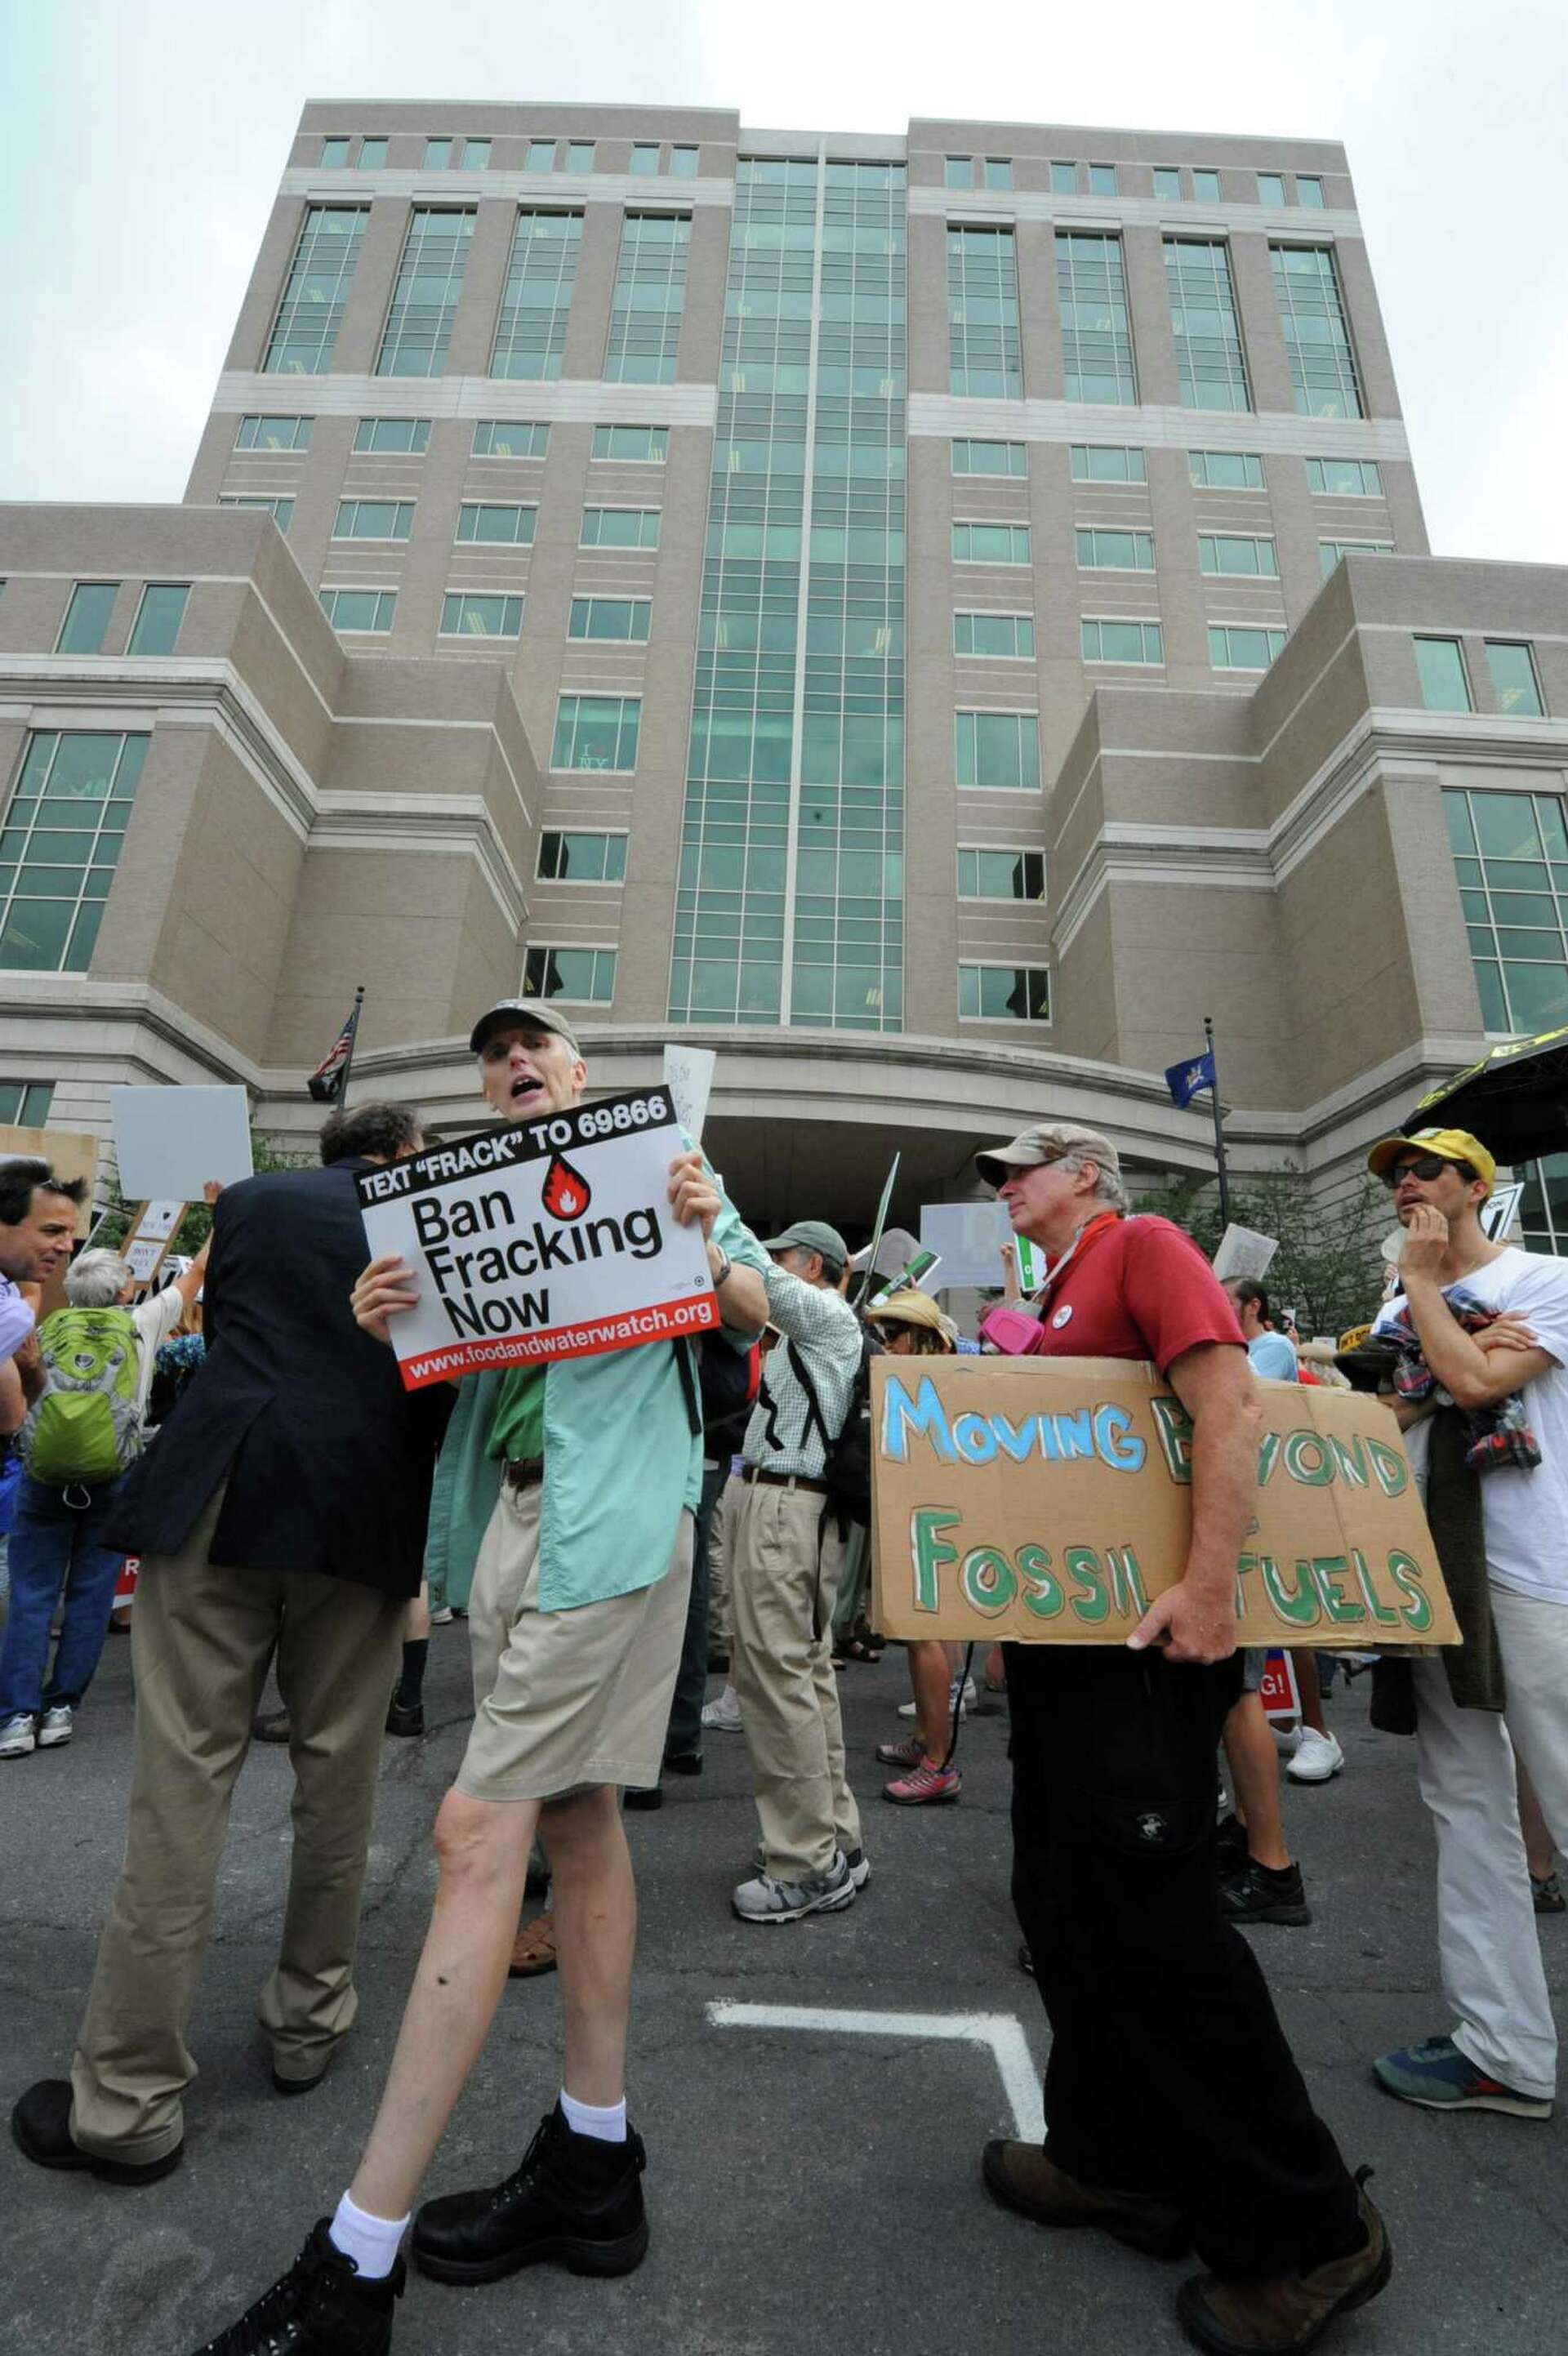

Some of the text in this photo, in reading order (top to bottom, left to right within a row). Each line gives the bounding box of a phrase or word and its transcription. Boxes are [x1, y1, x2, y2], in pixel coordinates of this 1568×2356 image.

[360, 1095, 667, 1200] TEXT “FRACK” TO 69866
[412, 1190, 514, 1247] Ban
[424, 1207, 662, 1294] Fracking
[409, 1302, 712, 1379] www.foodandwaterwatch.org
[442, 1288, 550, 1338] Now
[880, 1374, 1408, 1497] MOVING BYOND
[909, 1504, 1154, 1625] FOSSIL
